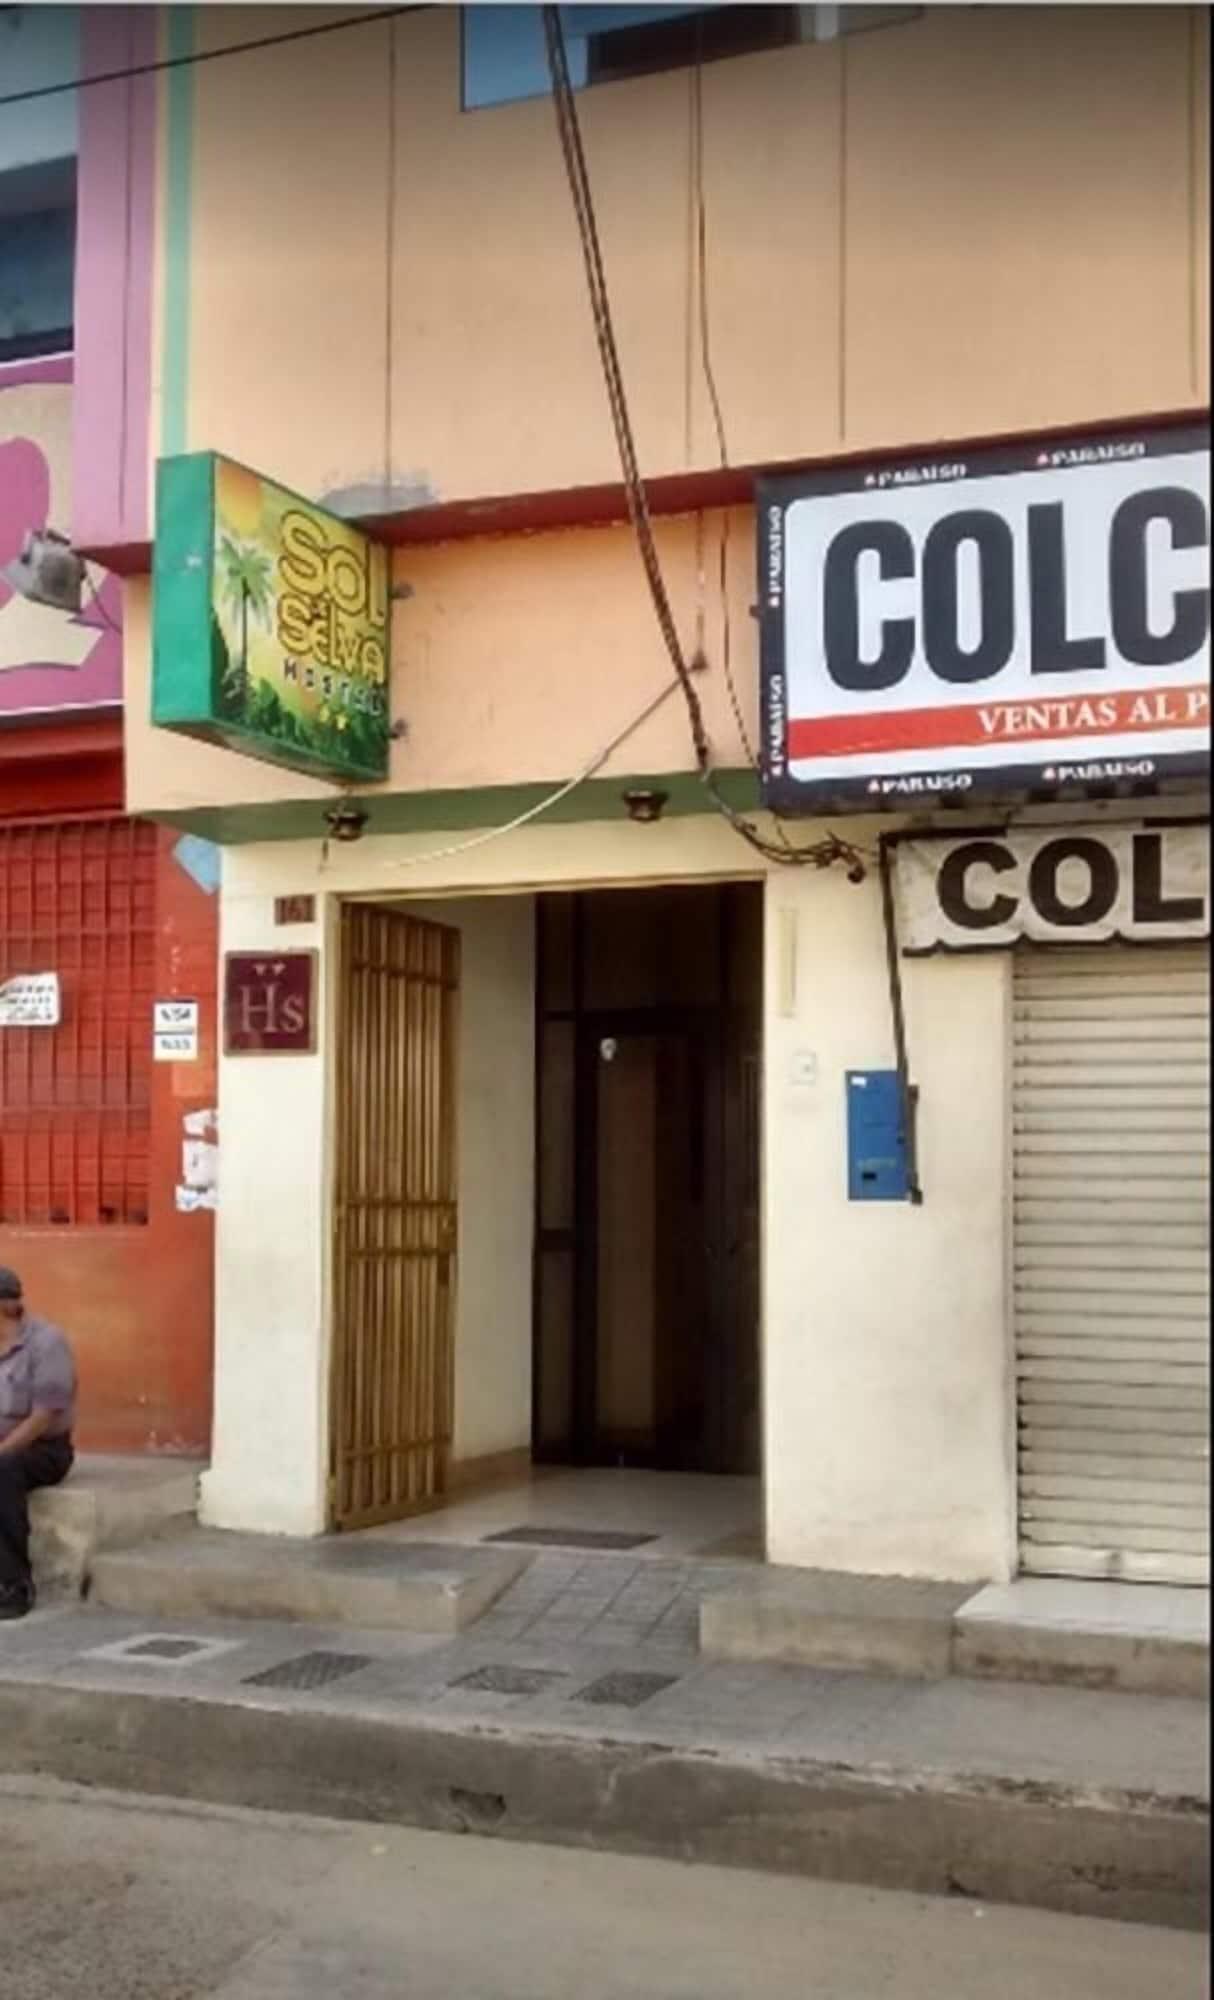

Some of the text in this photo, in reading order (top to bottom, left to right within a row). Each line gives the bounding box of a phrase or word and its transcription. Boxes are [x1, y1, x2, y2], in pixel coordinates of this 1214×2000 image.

[824, 487, 1208, 691] COLC
[978, 700, 1118, 734] VENTAS
[1128, 694, 1177, 724] AL
[937, 834, 1205, 929] COL
[239, 983, 305, 1033] Hs
